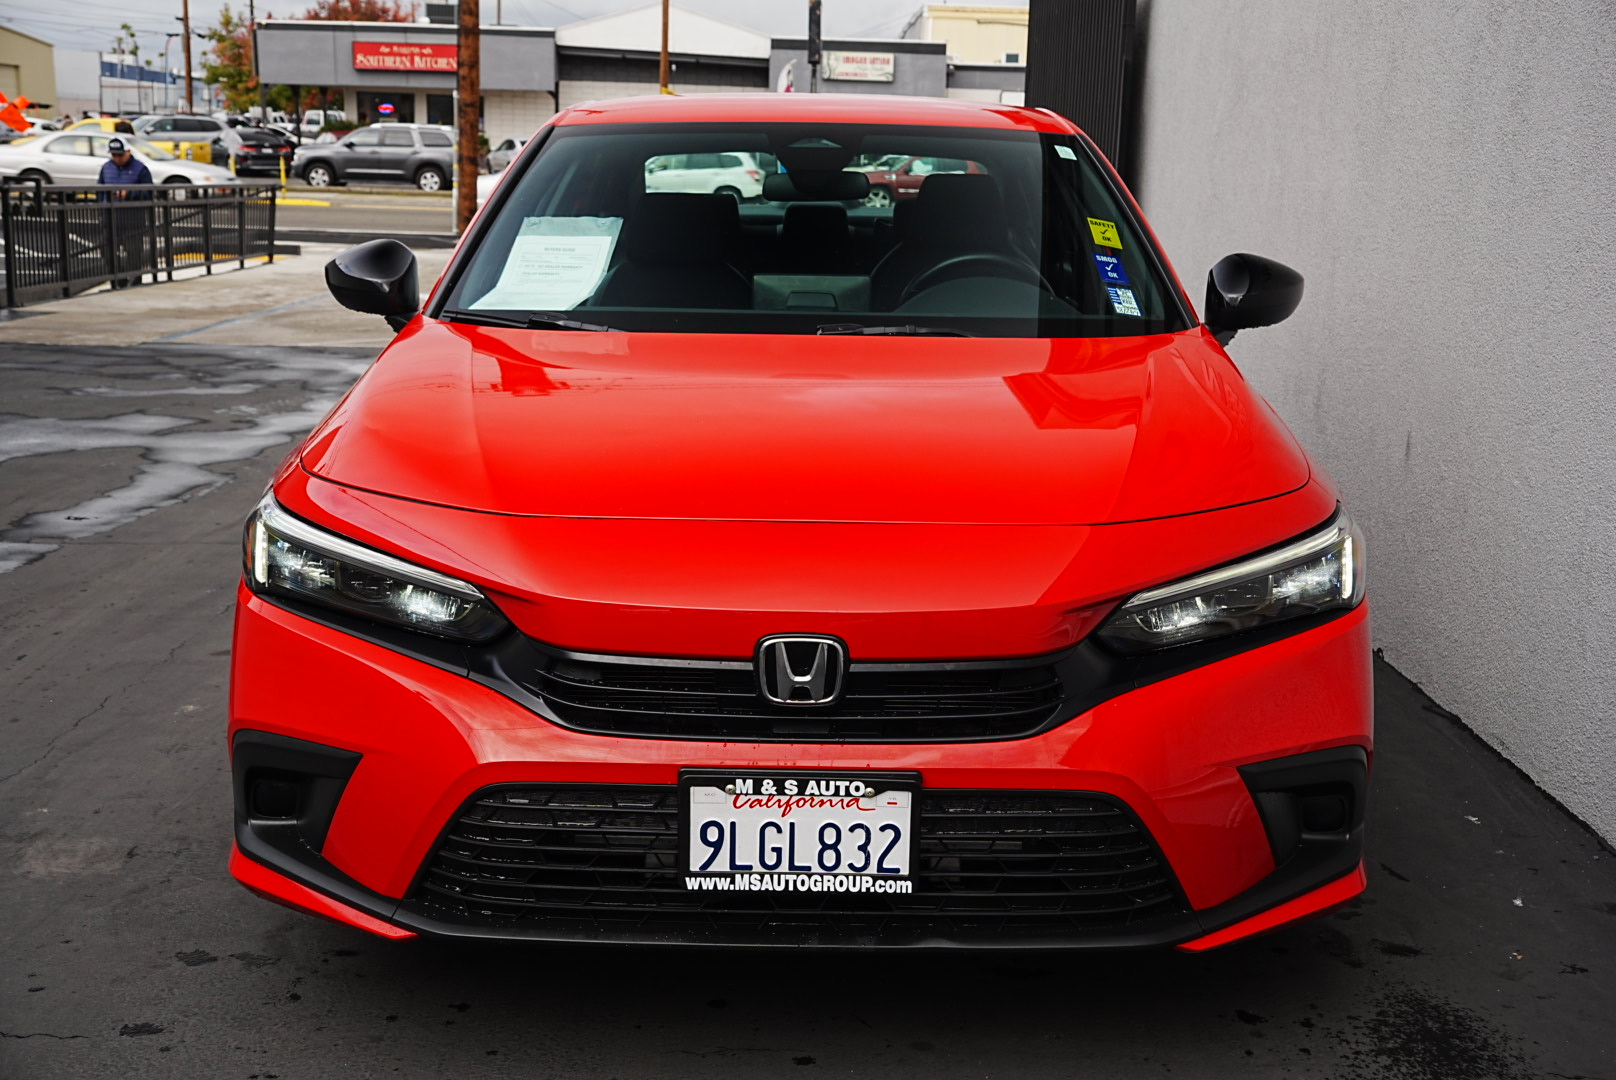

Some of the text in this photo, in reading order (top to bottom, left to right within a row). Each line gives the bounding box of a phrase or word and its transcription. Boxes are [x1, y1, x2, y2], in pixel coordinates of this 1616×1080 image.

[356, 54, 458, 69] SOUTHERN KITCHEN
[1089, 220, 1115, 229] SAFETY
[1095, 255, 1118, 264] SMOG
[1107, 271, 1119, 279] OK
[735, 779, 866, 797] M & S AUTO
[733, 794, 876, 817] California
[699, 820, 902, 873] 9LGL832
[685, 874, 913, 894] www.MSAUTOGROUP.com
